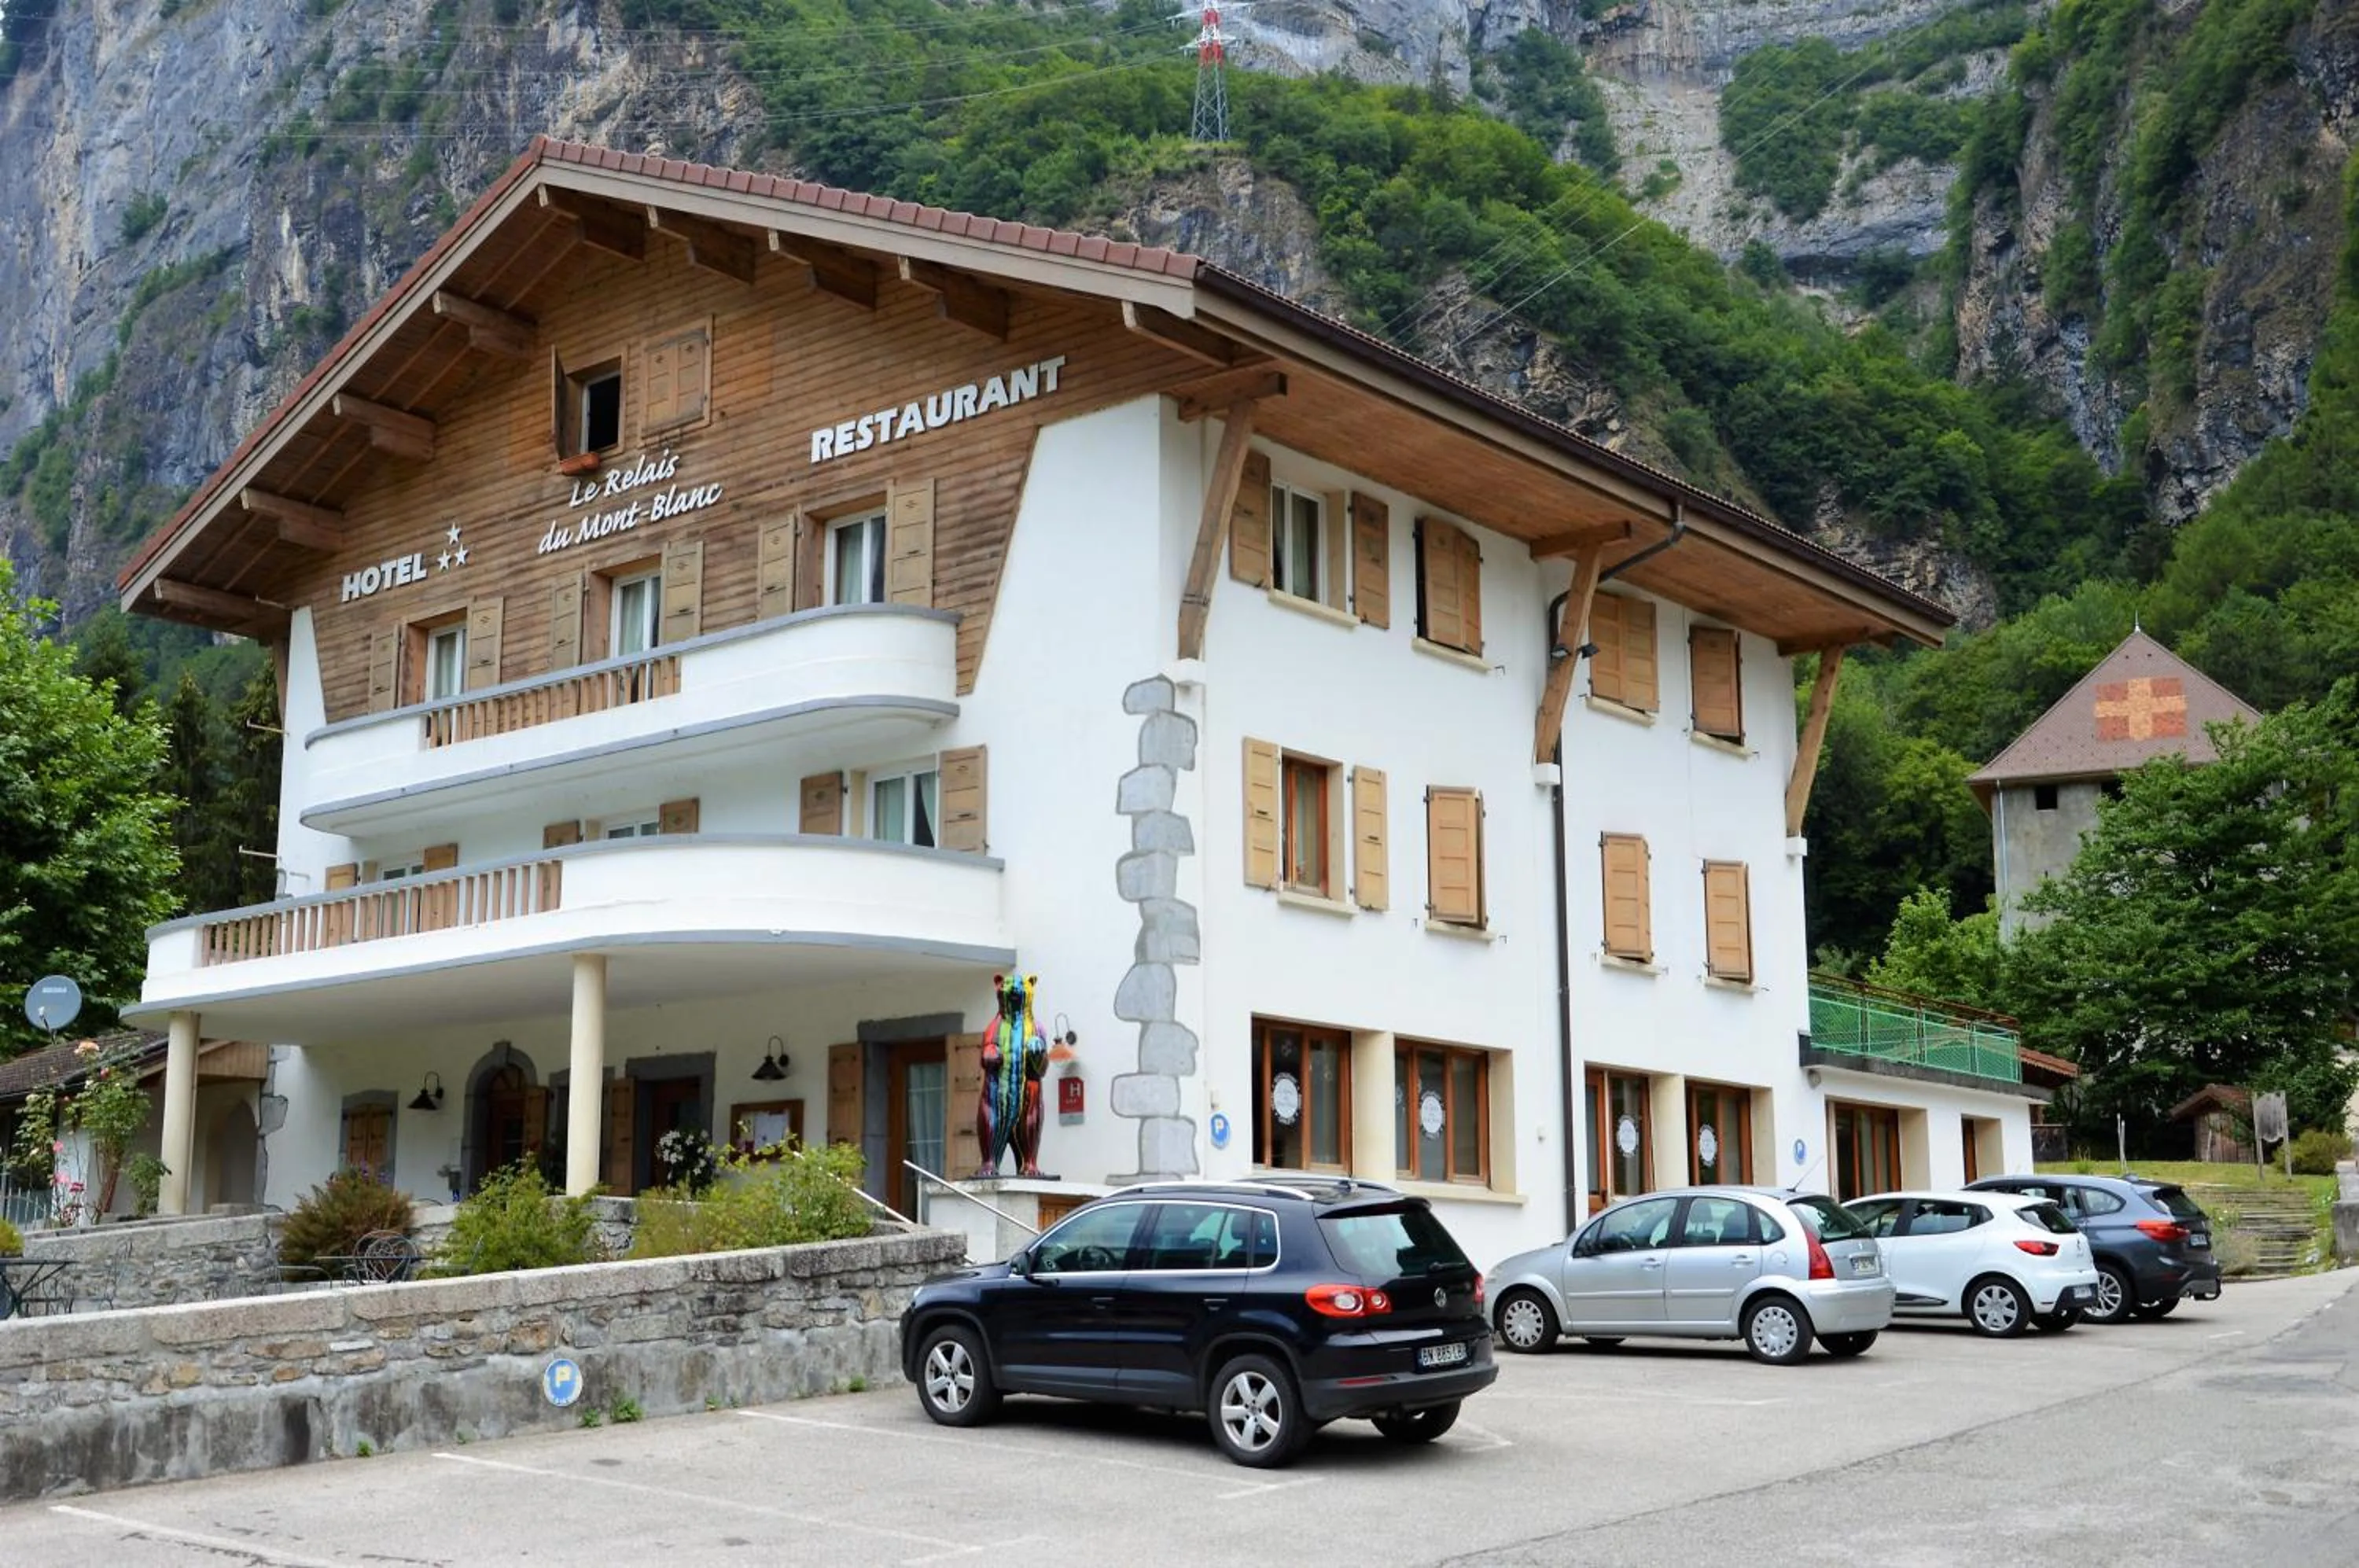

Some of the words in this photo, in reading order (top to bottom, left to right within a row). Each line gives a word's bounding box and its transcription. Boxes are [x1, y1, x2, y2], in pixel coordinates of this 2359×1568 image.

[811, 355, 1065, 464] RESTAURANT
[569, 480, 602, 508] Le
[603, 447, 680, 497] Relais
[538, 519, 575, 554] du
[574, 482, 723, 544] Mont-Blanc
[341, 553, 428, 603] HOTEL
[1069, 1081, 1082, 1096] H
[555, 1365, 572, 1389] P
